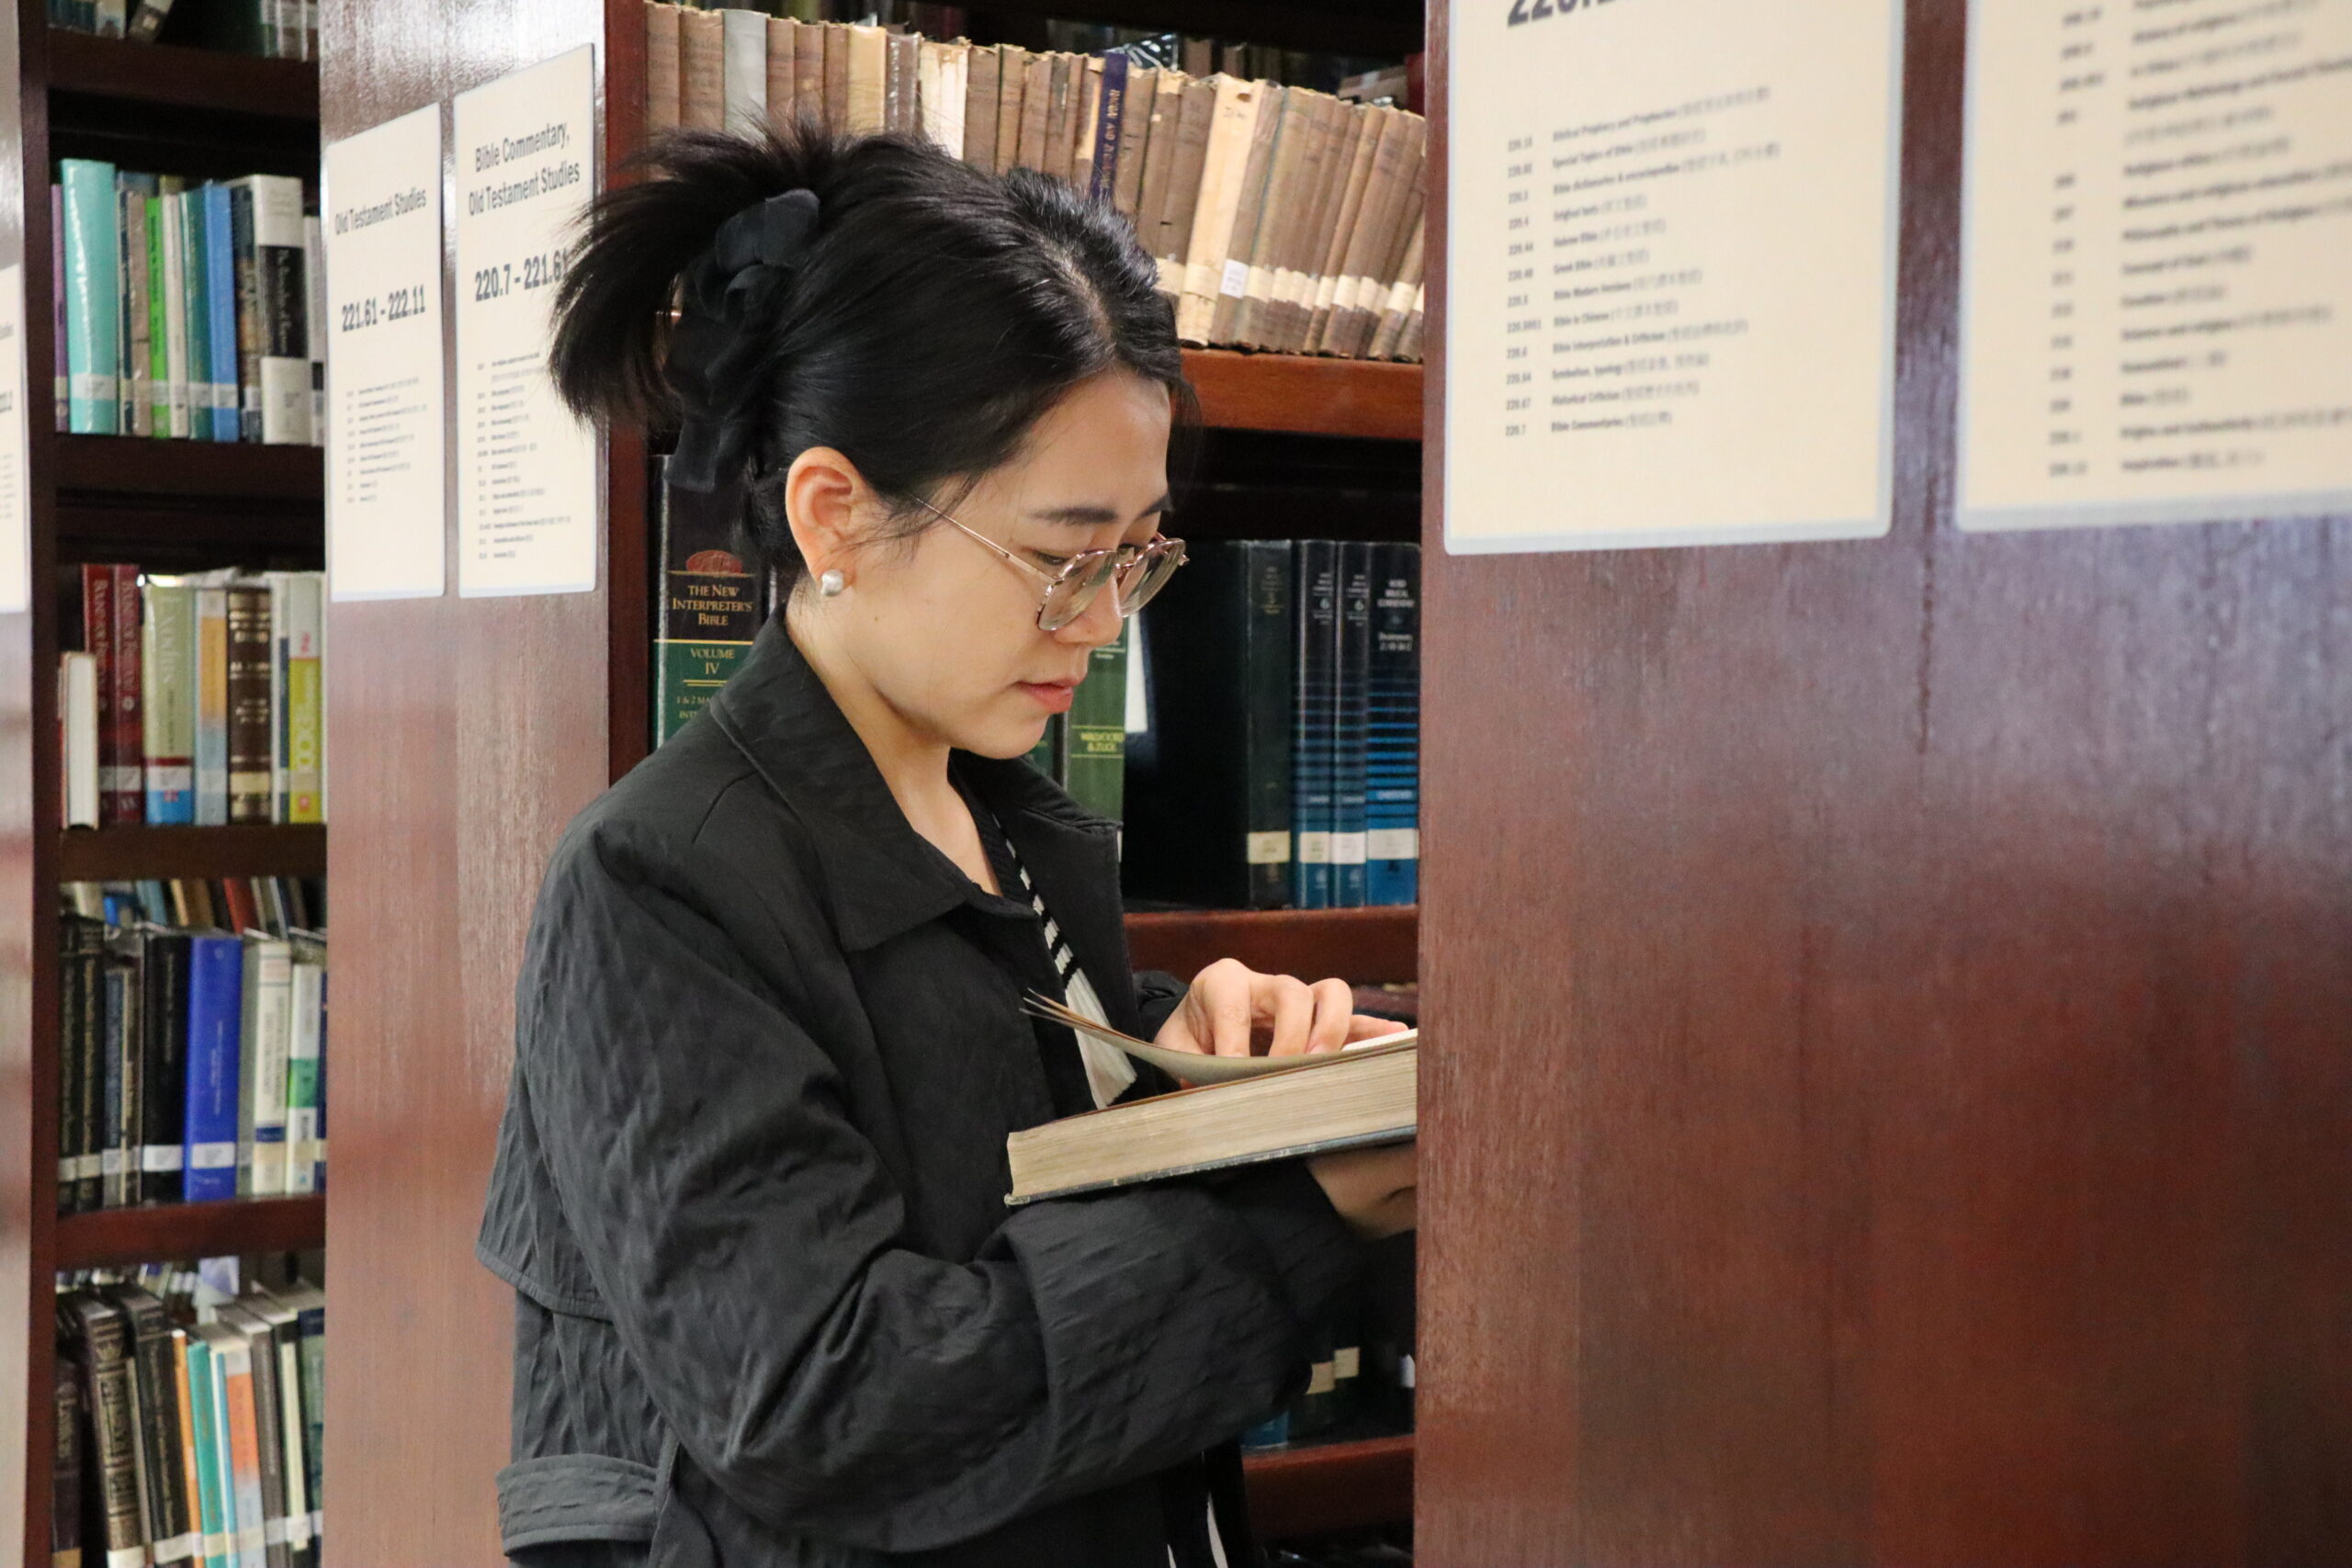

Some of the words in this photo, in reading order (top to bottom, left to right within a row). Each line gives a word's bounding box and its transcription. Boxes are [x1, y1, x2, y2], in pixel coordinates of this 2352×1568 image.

[475, 145, 500, 173] Bible
[503, 121, 570, 164] Commentary,
[469, 189, 484, 217] Old
[486, 172, 539, 212] Testament
[541, 160, 581, 194] Studies
[334, 211, 349, 235] Old
[350, 199, 392, 231] Testament
[394, 186, 426, 217] Studies
[474, 263, 511, 302] 220.7
[342, 296, 378, 333] 221.61
[388, 284, 426, 321] 222.11
[688, 585, 709, 596] THE
[712, 583, 740, 596] NEW
[672, 597, 753, 612] INTERPRETER'S
[698, 613, 729, 626] BIBLE
[690, 648, 735, 660] VOLUME
[705, 661, 719, 674] IV
